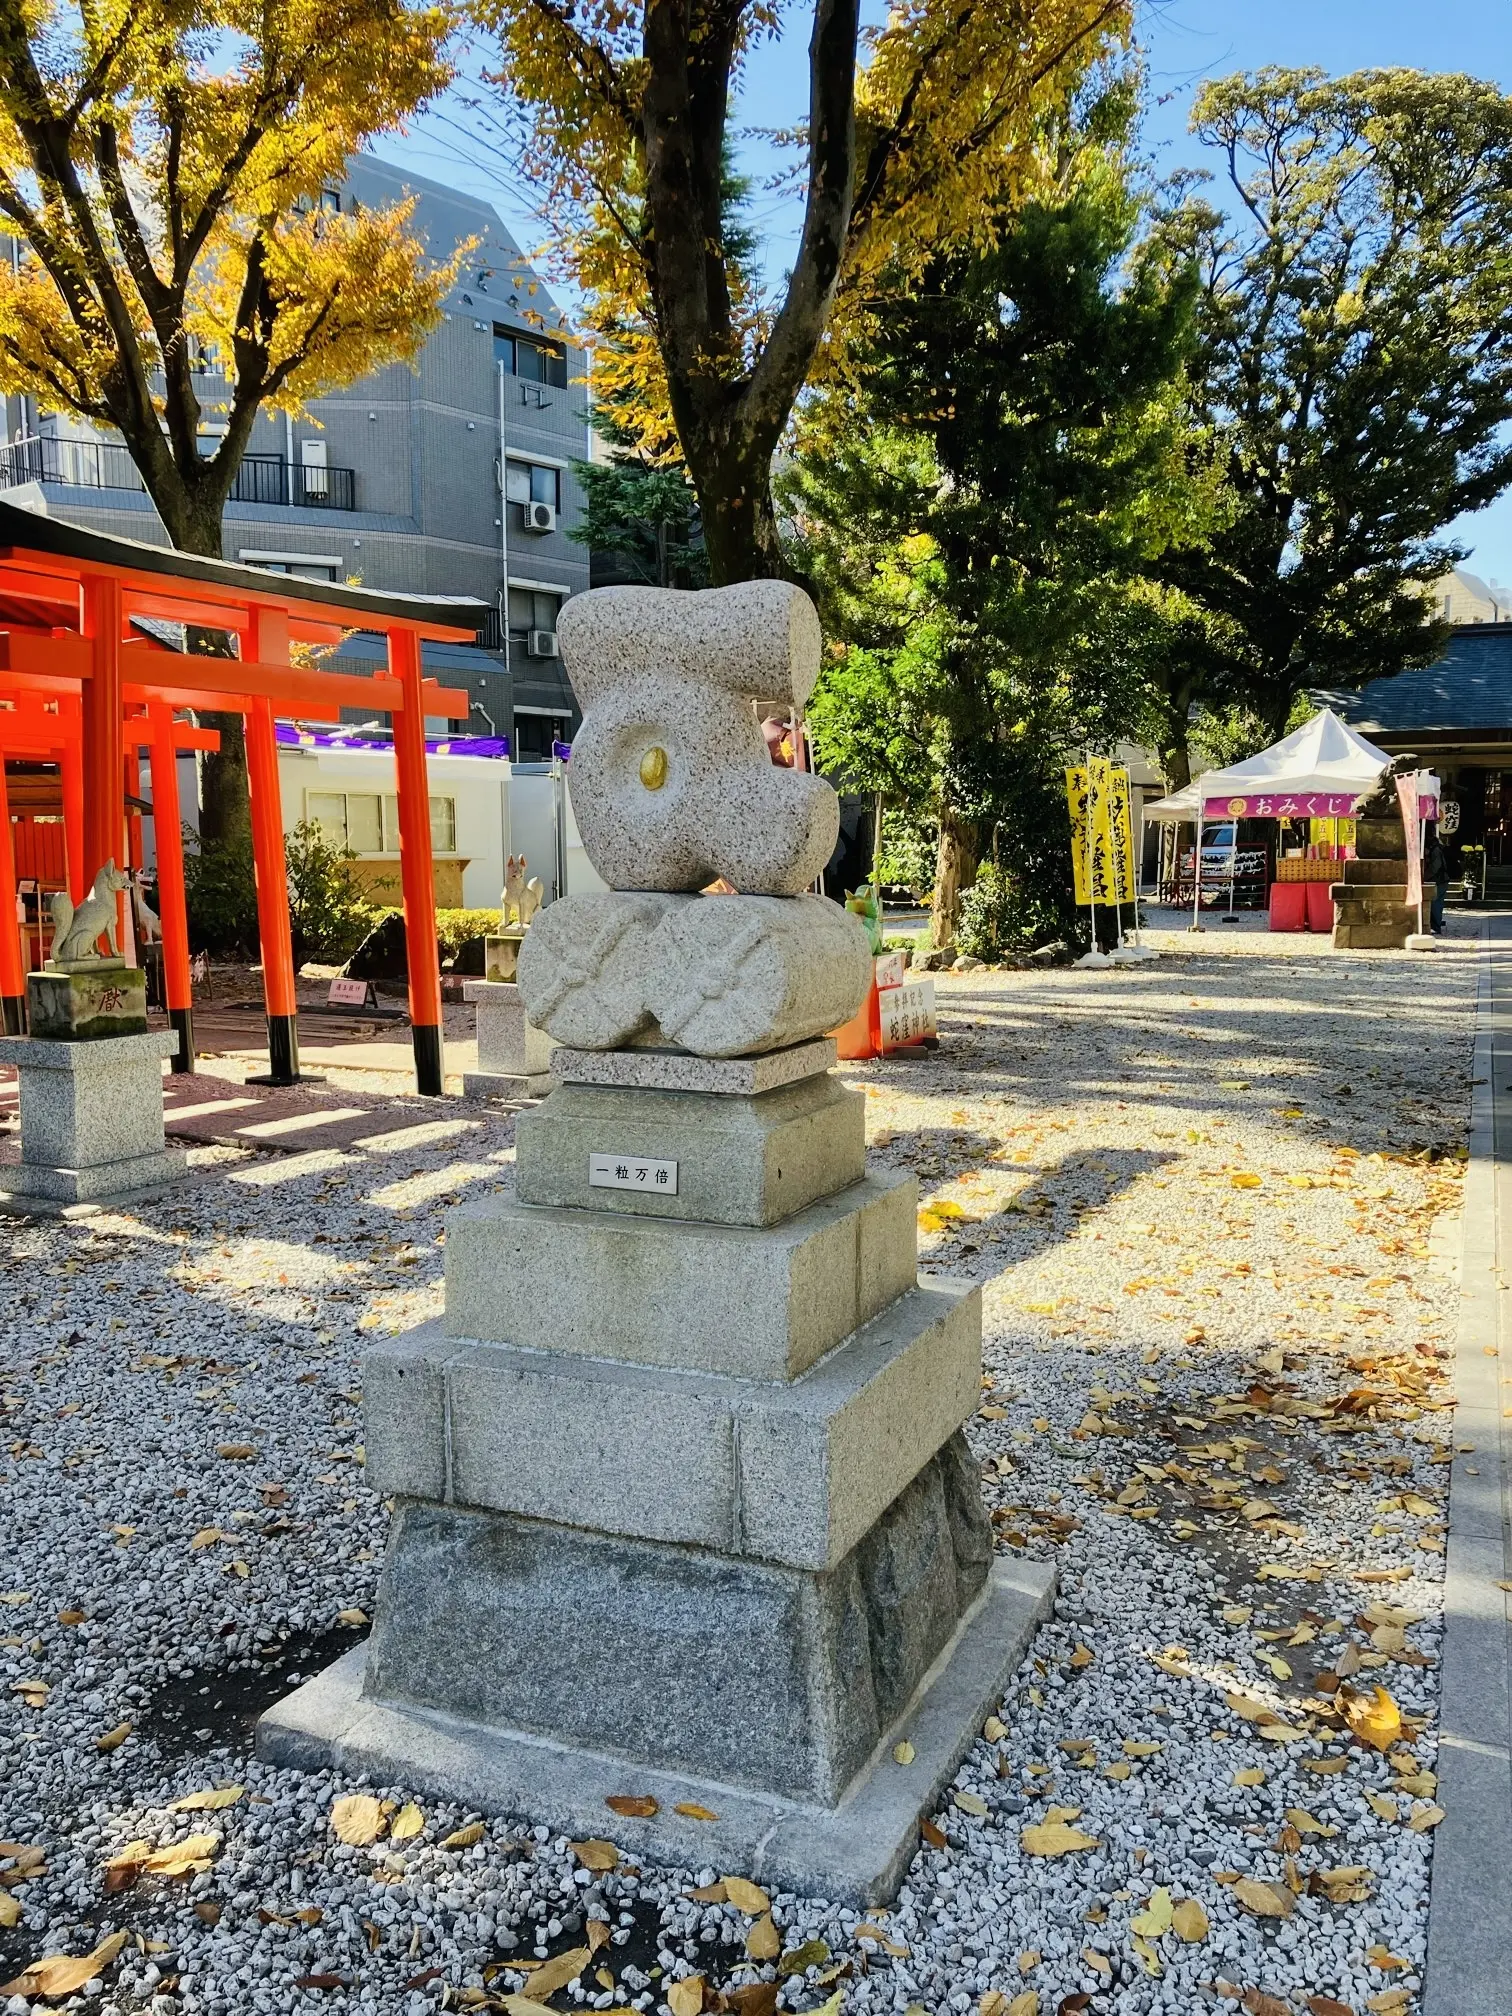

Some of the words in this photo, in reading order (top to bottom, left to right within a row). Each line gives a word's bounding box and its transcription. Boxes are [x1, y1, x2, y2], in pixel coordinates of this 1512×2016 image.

[1255, 797, 1358, 816] おみくじ
[1444, 802, 1459, 830] 蛇窪
[889, 1008, 930, 1042] 蛇窪神社
[595, 1164, 669, 1184] 一粒万倍
